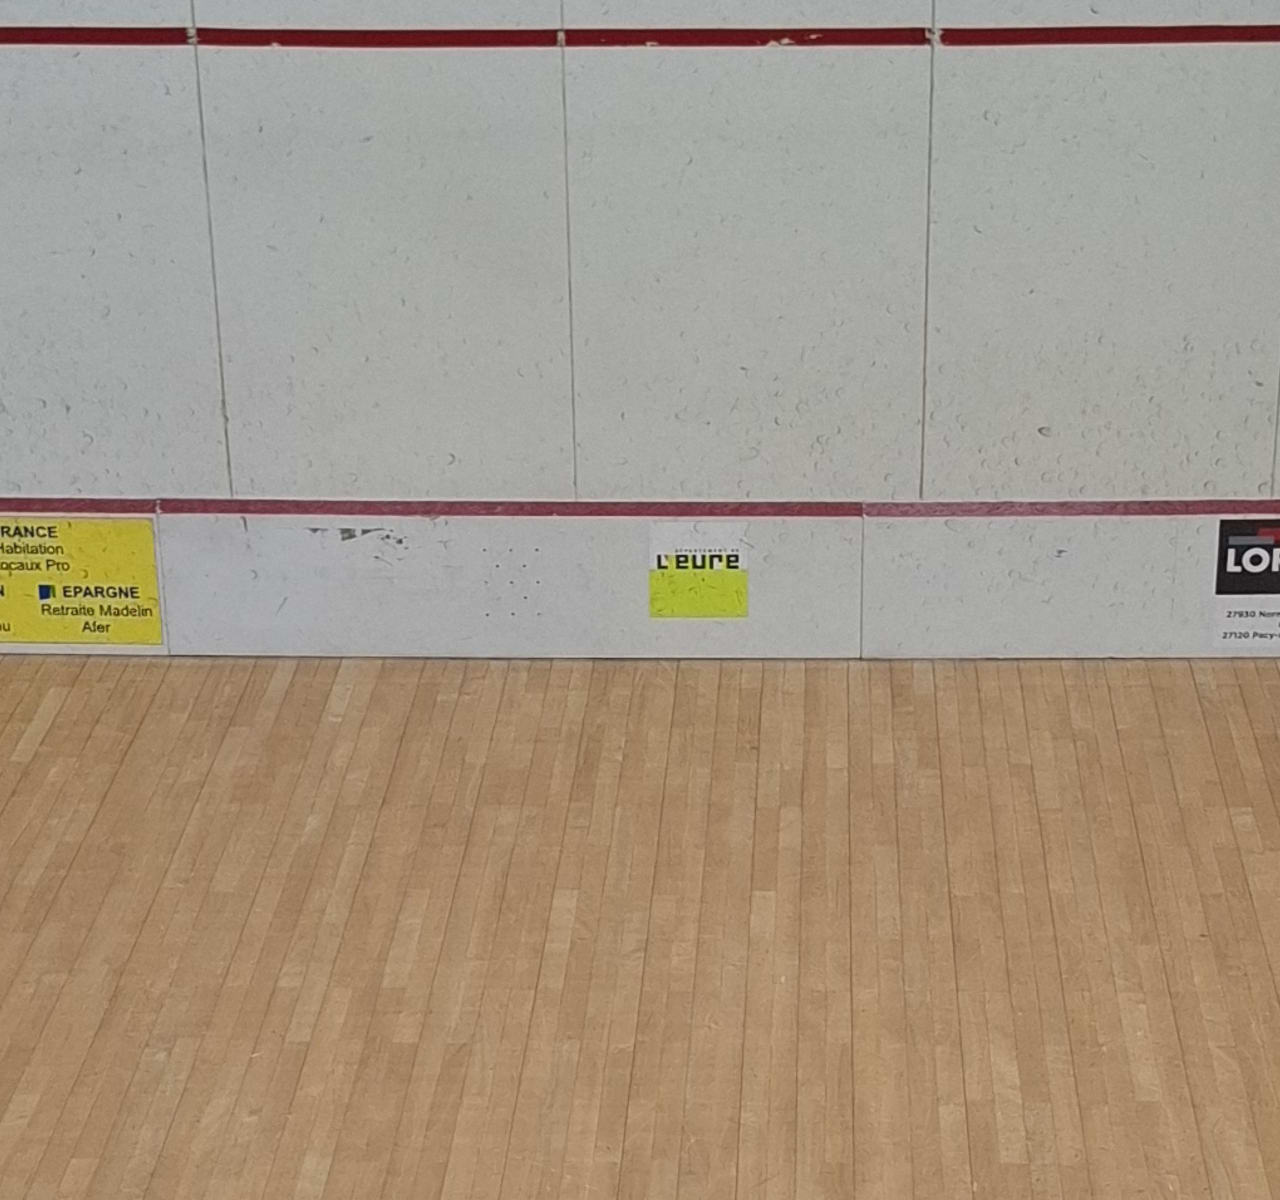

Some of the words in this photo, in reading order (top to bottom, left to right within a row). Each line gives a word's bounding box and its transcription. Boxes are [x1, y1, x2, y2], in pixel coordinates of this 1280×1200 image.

[46, 560, 70, 571] Pro
[62, 586, 140, 599] EPARGNE
[41, 604, 95, 616] Retraite
[99, 604, 153, 617] Madelin
[82, 621, 111, 633] Afer
